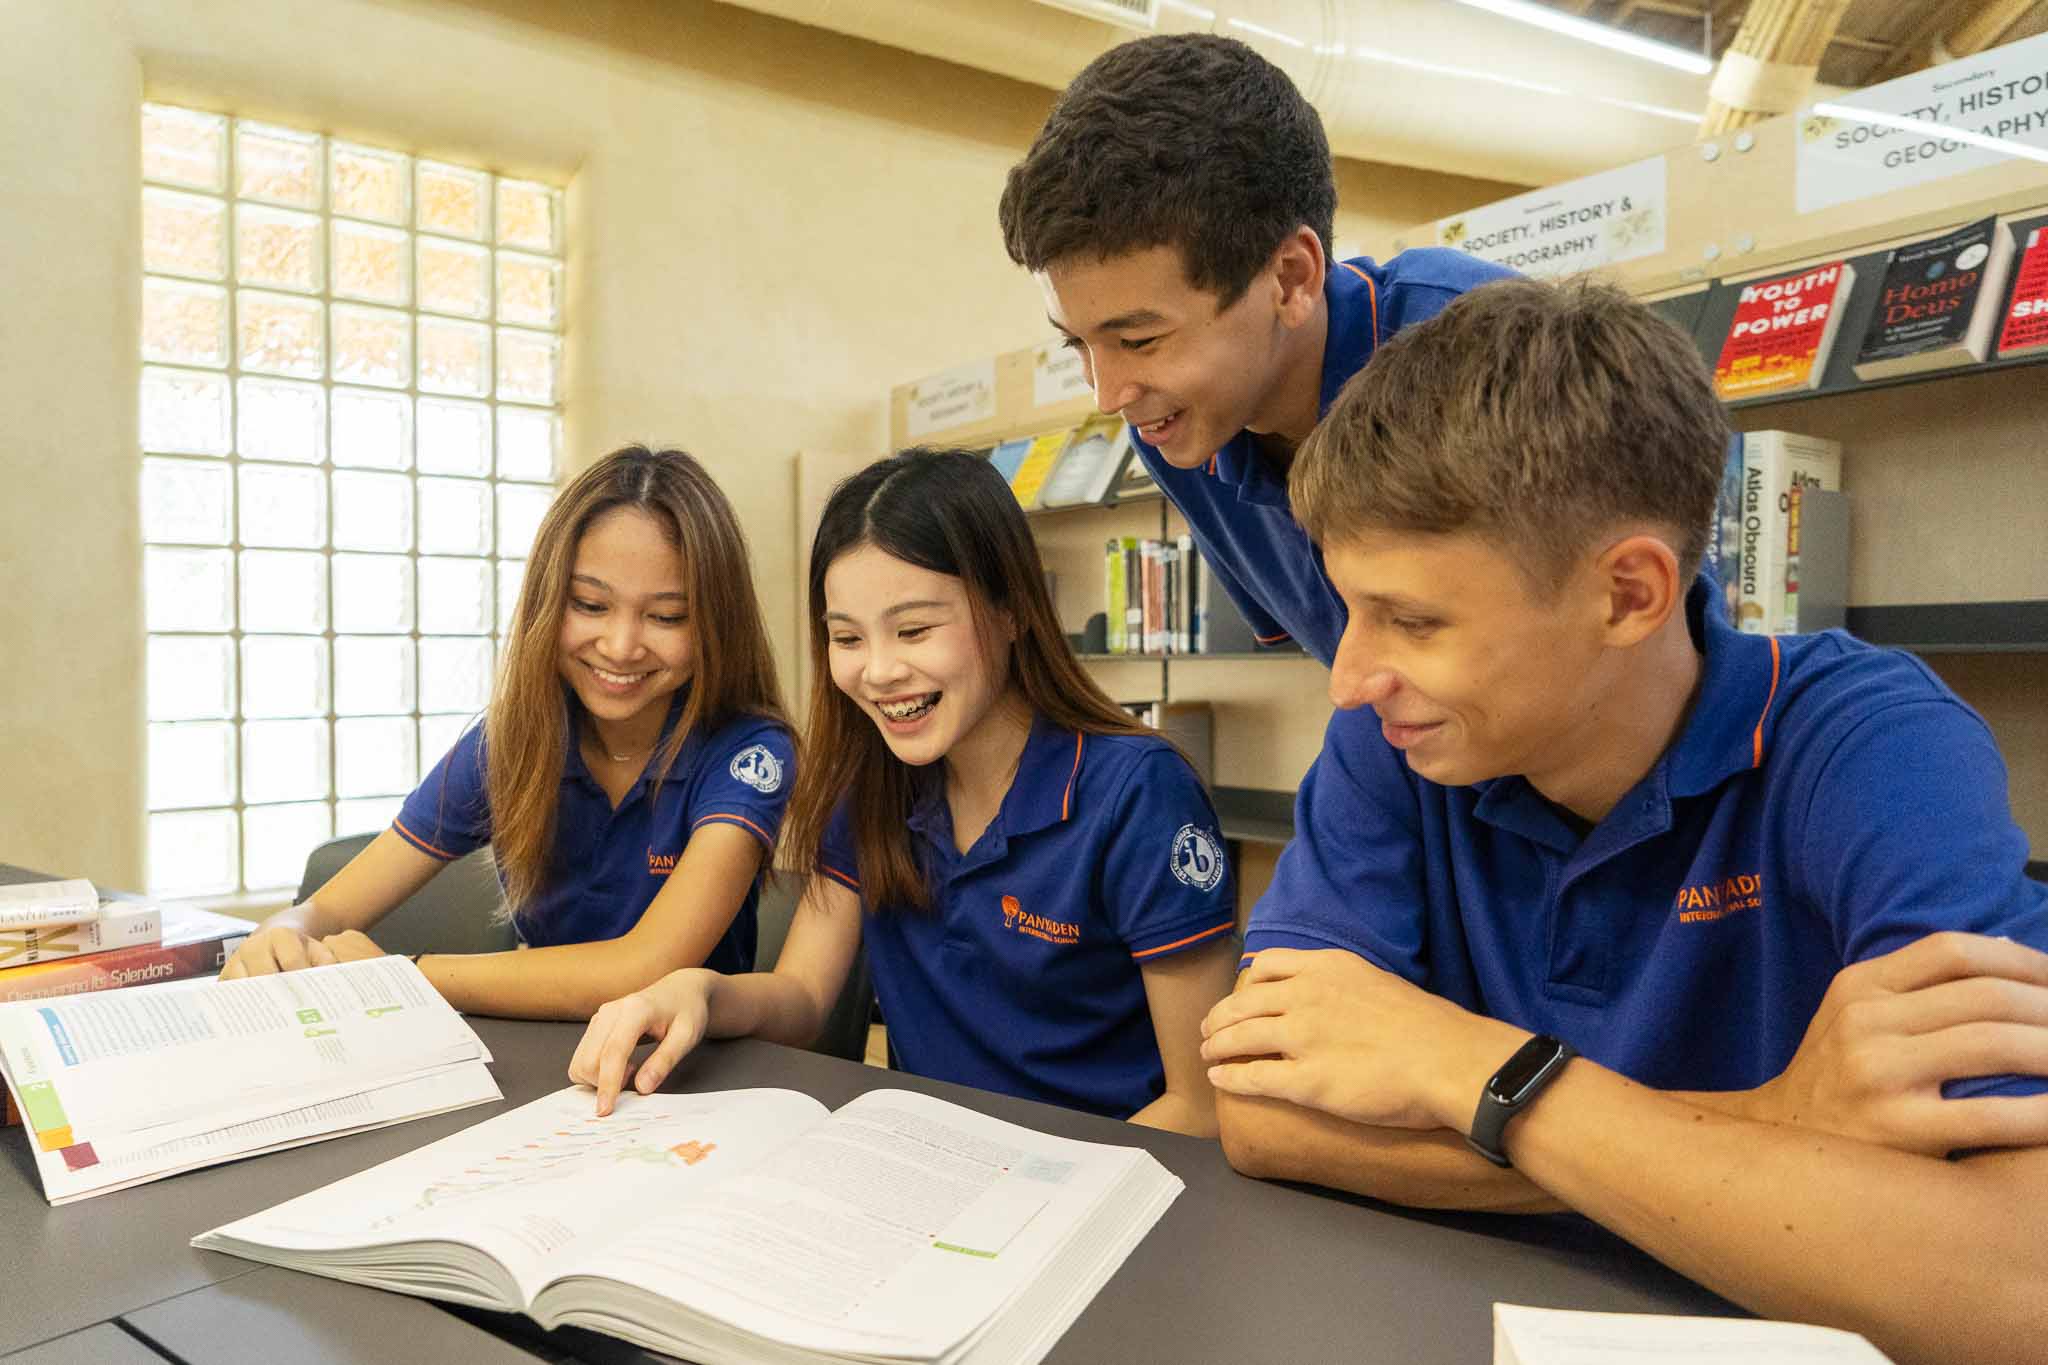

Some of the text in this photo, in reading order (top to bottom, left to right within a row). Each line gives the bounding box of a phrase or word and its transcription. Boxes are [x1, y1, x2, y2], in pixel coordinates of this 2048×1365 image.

[1959, 75, 2048, 115] HISTO
[1539, 200, 1616, 234] HISTORY
[1620, 196, 1632, 212] &
[1744, 267, 1838, 303] YOUTH
[1884, 272, 1978, 305] Homo
[1732, 303, 1829, 338] POWER
[1773, 297, 1802, 313] TO
[1886, 298, 1962, 326] Deus
[1746, 467, 1764, 511] Atlas
[1743, 515, 1762, 595] Obscura
[111, 961, 174, 986] Splendors
